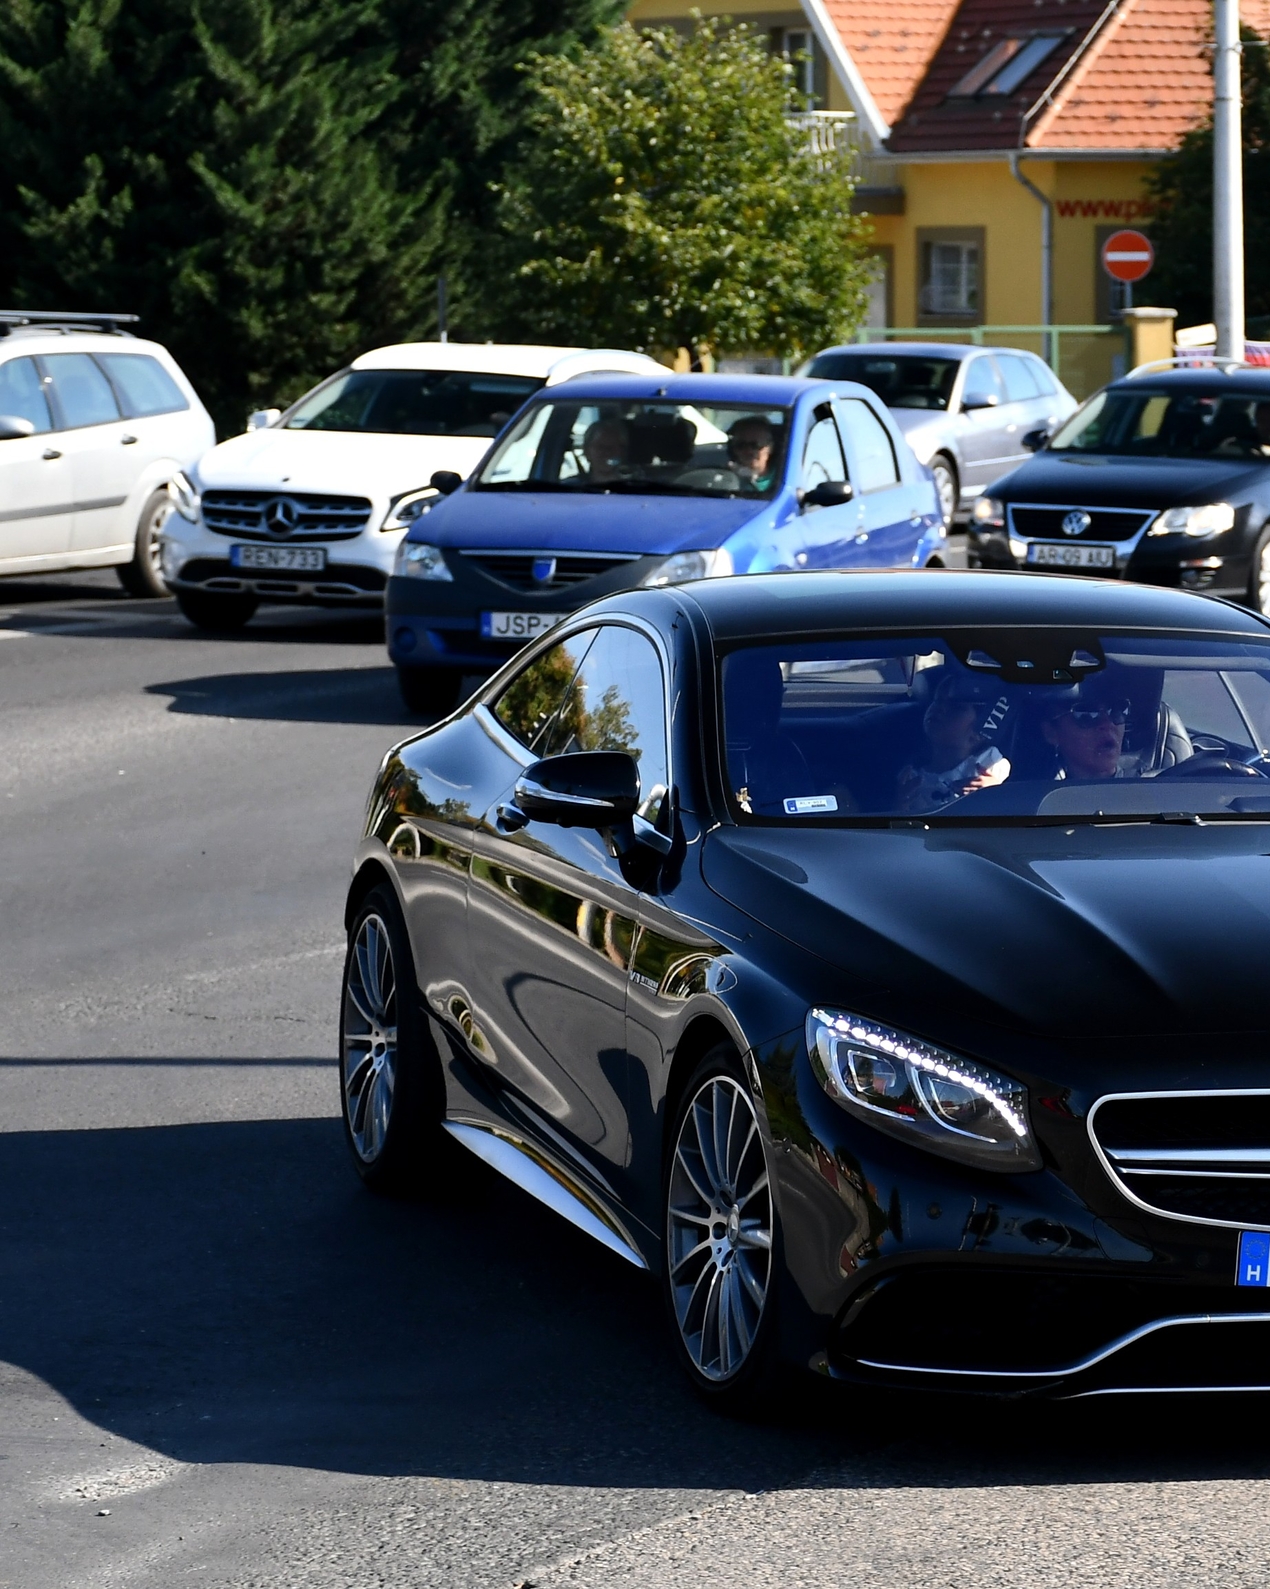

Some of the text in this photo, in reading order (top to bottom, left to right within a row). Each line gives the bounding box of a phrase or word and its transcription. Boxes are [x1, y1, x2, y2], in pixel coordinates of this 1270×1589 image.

[496, 615, 560, 634] JSP-
[983, 696, 1010, 729] VIP
[1246, 1265, 1260, 1281] H
